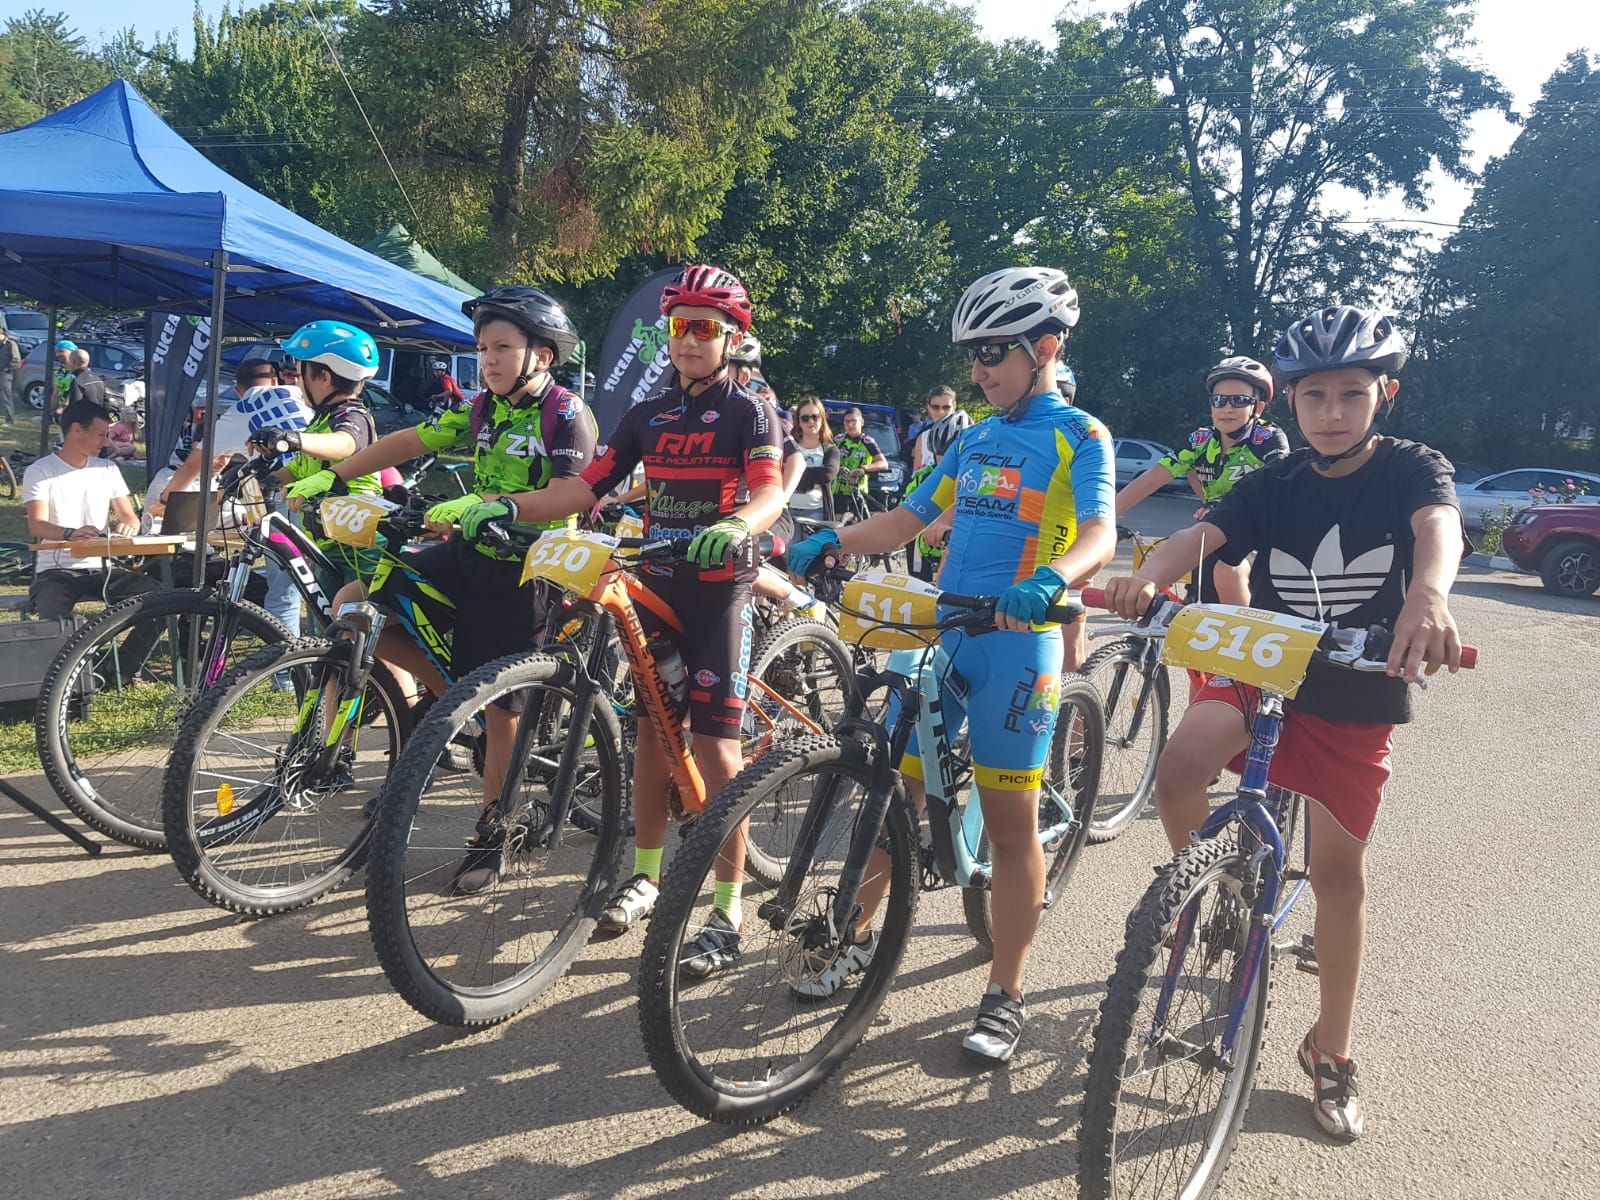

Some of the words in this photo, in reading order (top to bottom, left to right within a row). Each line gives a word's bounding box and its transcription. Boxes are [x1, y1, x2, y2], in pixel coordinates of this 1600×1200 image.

[1015, 281, 1045, 300] GIRO
[152, 313, 182, 365] SUCEA
[603, 337, 644, 393] SUCEAVA
[655, 431, 716, 455] RM
[665, 455, 737, 466] MOUNTAIN
[966, 452, 1027, 469] PICIU
[325, 499, 373, 533] 508
[957, 496, 1016, 514] TEAM
[530, 542, 592, 573] 510
[855, 591, 919, 635] 511
[1187, 616, 1291, 669] 516
[1003, 665, 1039, 734] PICIU
[618, 764, 627, 816] PATROL
[998, 774, 1035, 784] PICIU
